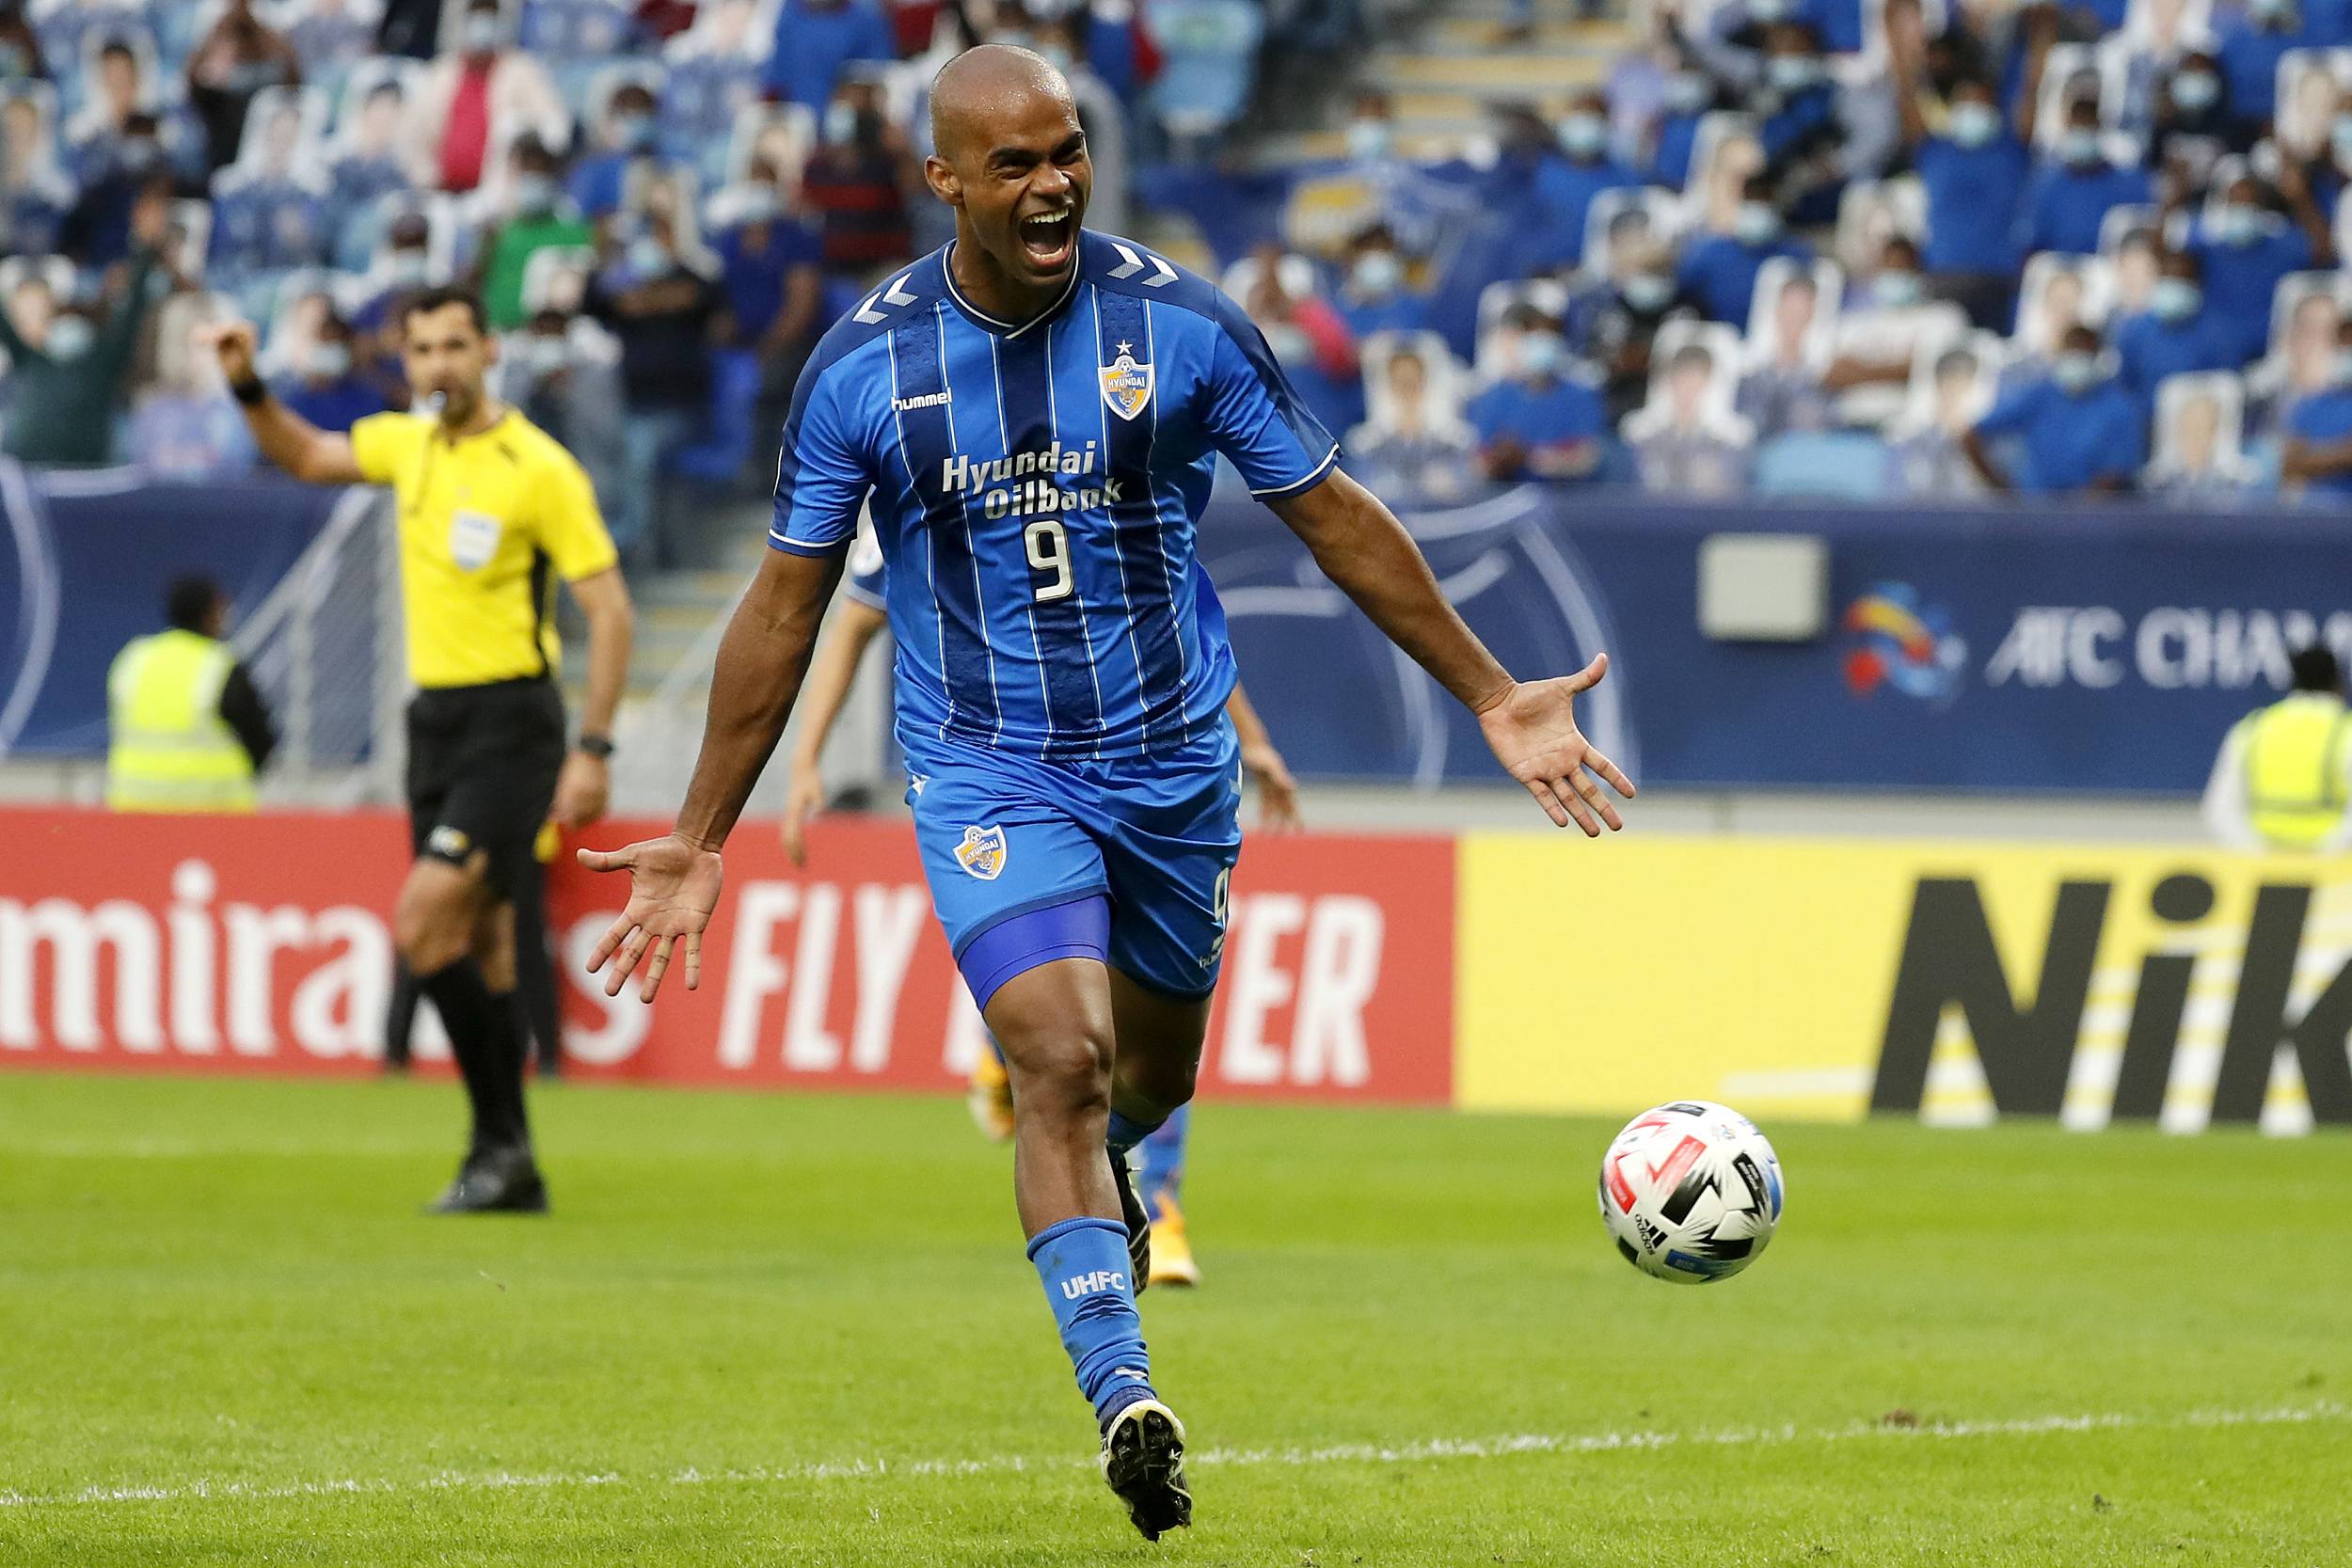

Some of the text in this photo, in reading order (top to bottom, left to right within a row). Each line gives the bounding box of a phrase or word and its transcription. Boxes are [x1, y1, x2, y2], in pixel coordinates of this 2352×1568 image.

[891, 387, 952, 412] hummel
[1108, 376, 1146, 389] HYUNDAI
[943, 440, 1096, 495] Hyundai
[984, 477, 1123, 520] Oilbank
[1025, 520, 1074, 602] 9
[964, 838, 1000, 861] HYUNDAI
[717, 879, 929, 1073] FLY
[1635, 1213, 1656, 1256] adidas
[1060, 1271, 1125, 1300] UHFC
